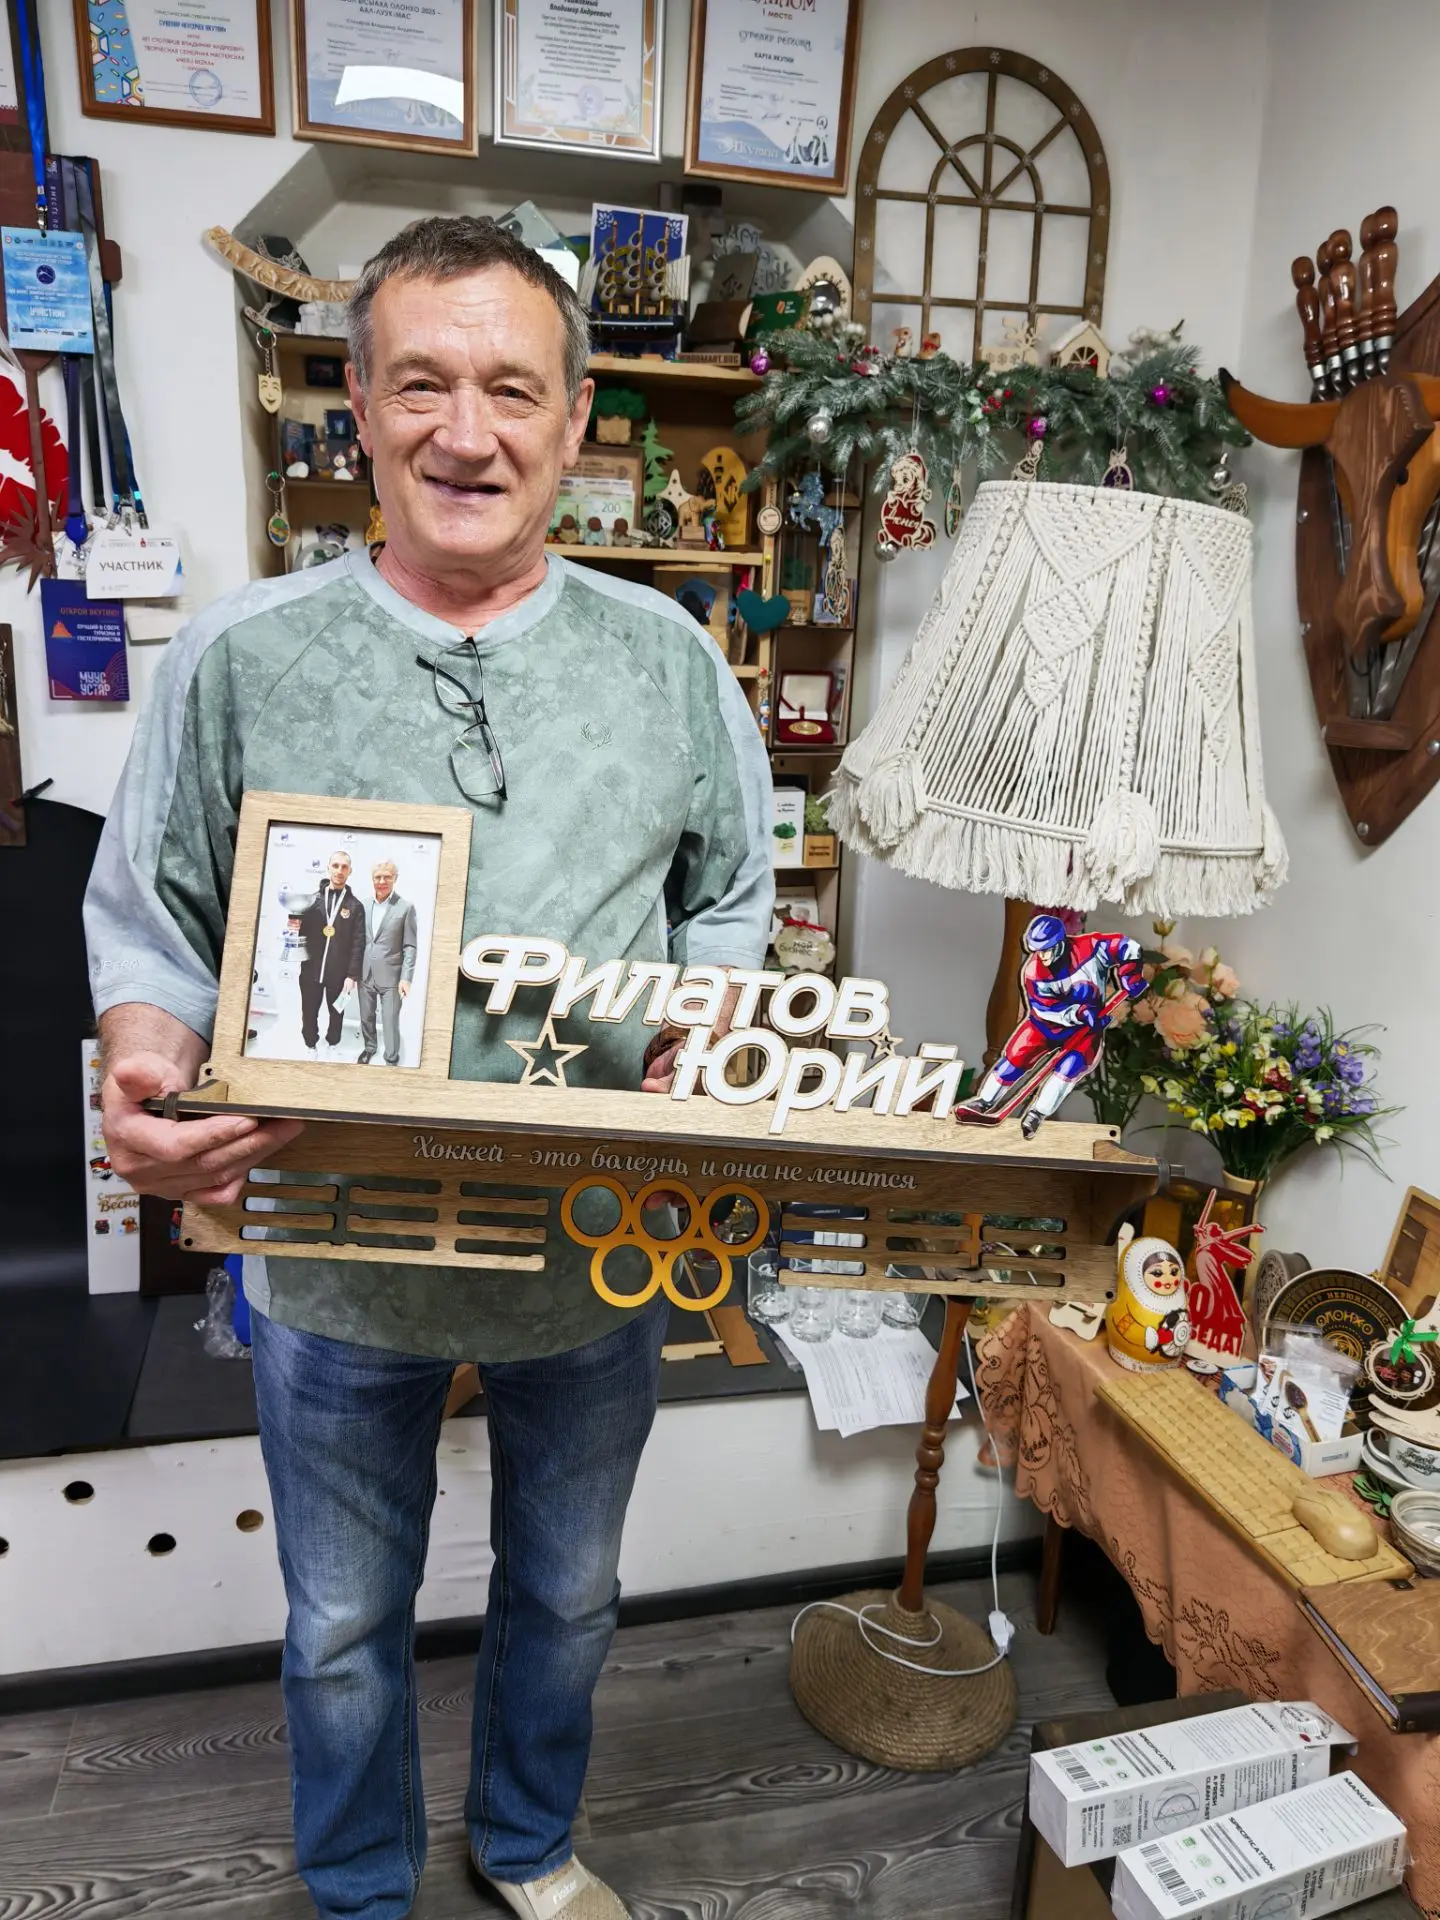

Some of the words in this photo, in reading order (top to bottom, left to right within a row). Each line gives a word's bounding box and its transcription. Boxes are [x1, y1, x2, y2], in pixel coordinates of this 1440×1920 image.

[768, 10, 793, 20] место
[602, 502, 621, 513] 200
[99, 560, 164, 572] УЧАСТНИК
[461, 934, 890, 1040] Филатов
[671, 1026, 964, 1134] Юрий
[413, 1135, 504, 1163] Хоккей
[529, 1149, 583, 1167] это
[590, 1144, 689, 1181] болезнь,
[700, 1160, 715, 1177] и
[722, 1161, 769, 1180] она
[775, 1164, 803, 1181] не
[807, 1168, 917, 1190] лечится
[1316, 1309, 1374, 1336] ОЛОНХО
